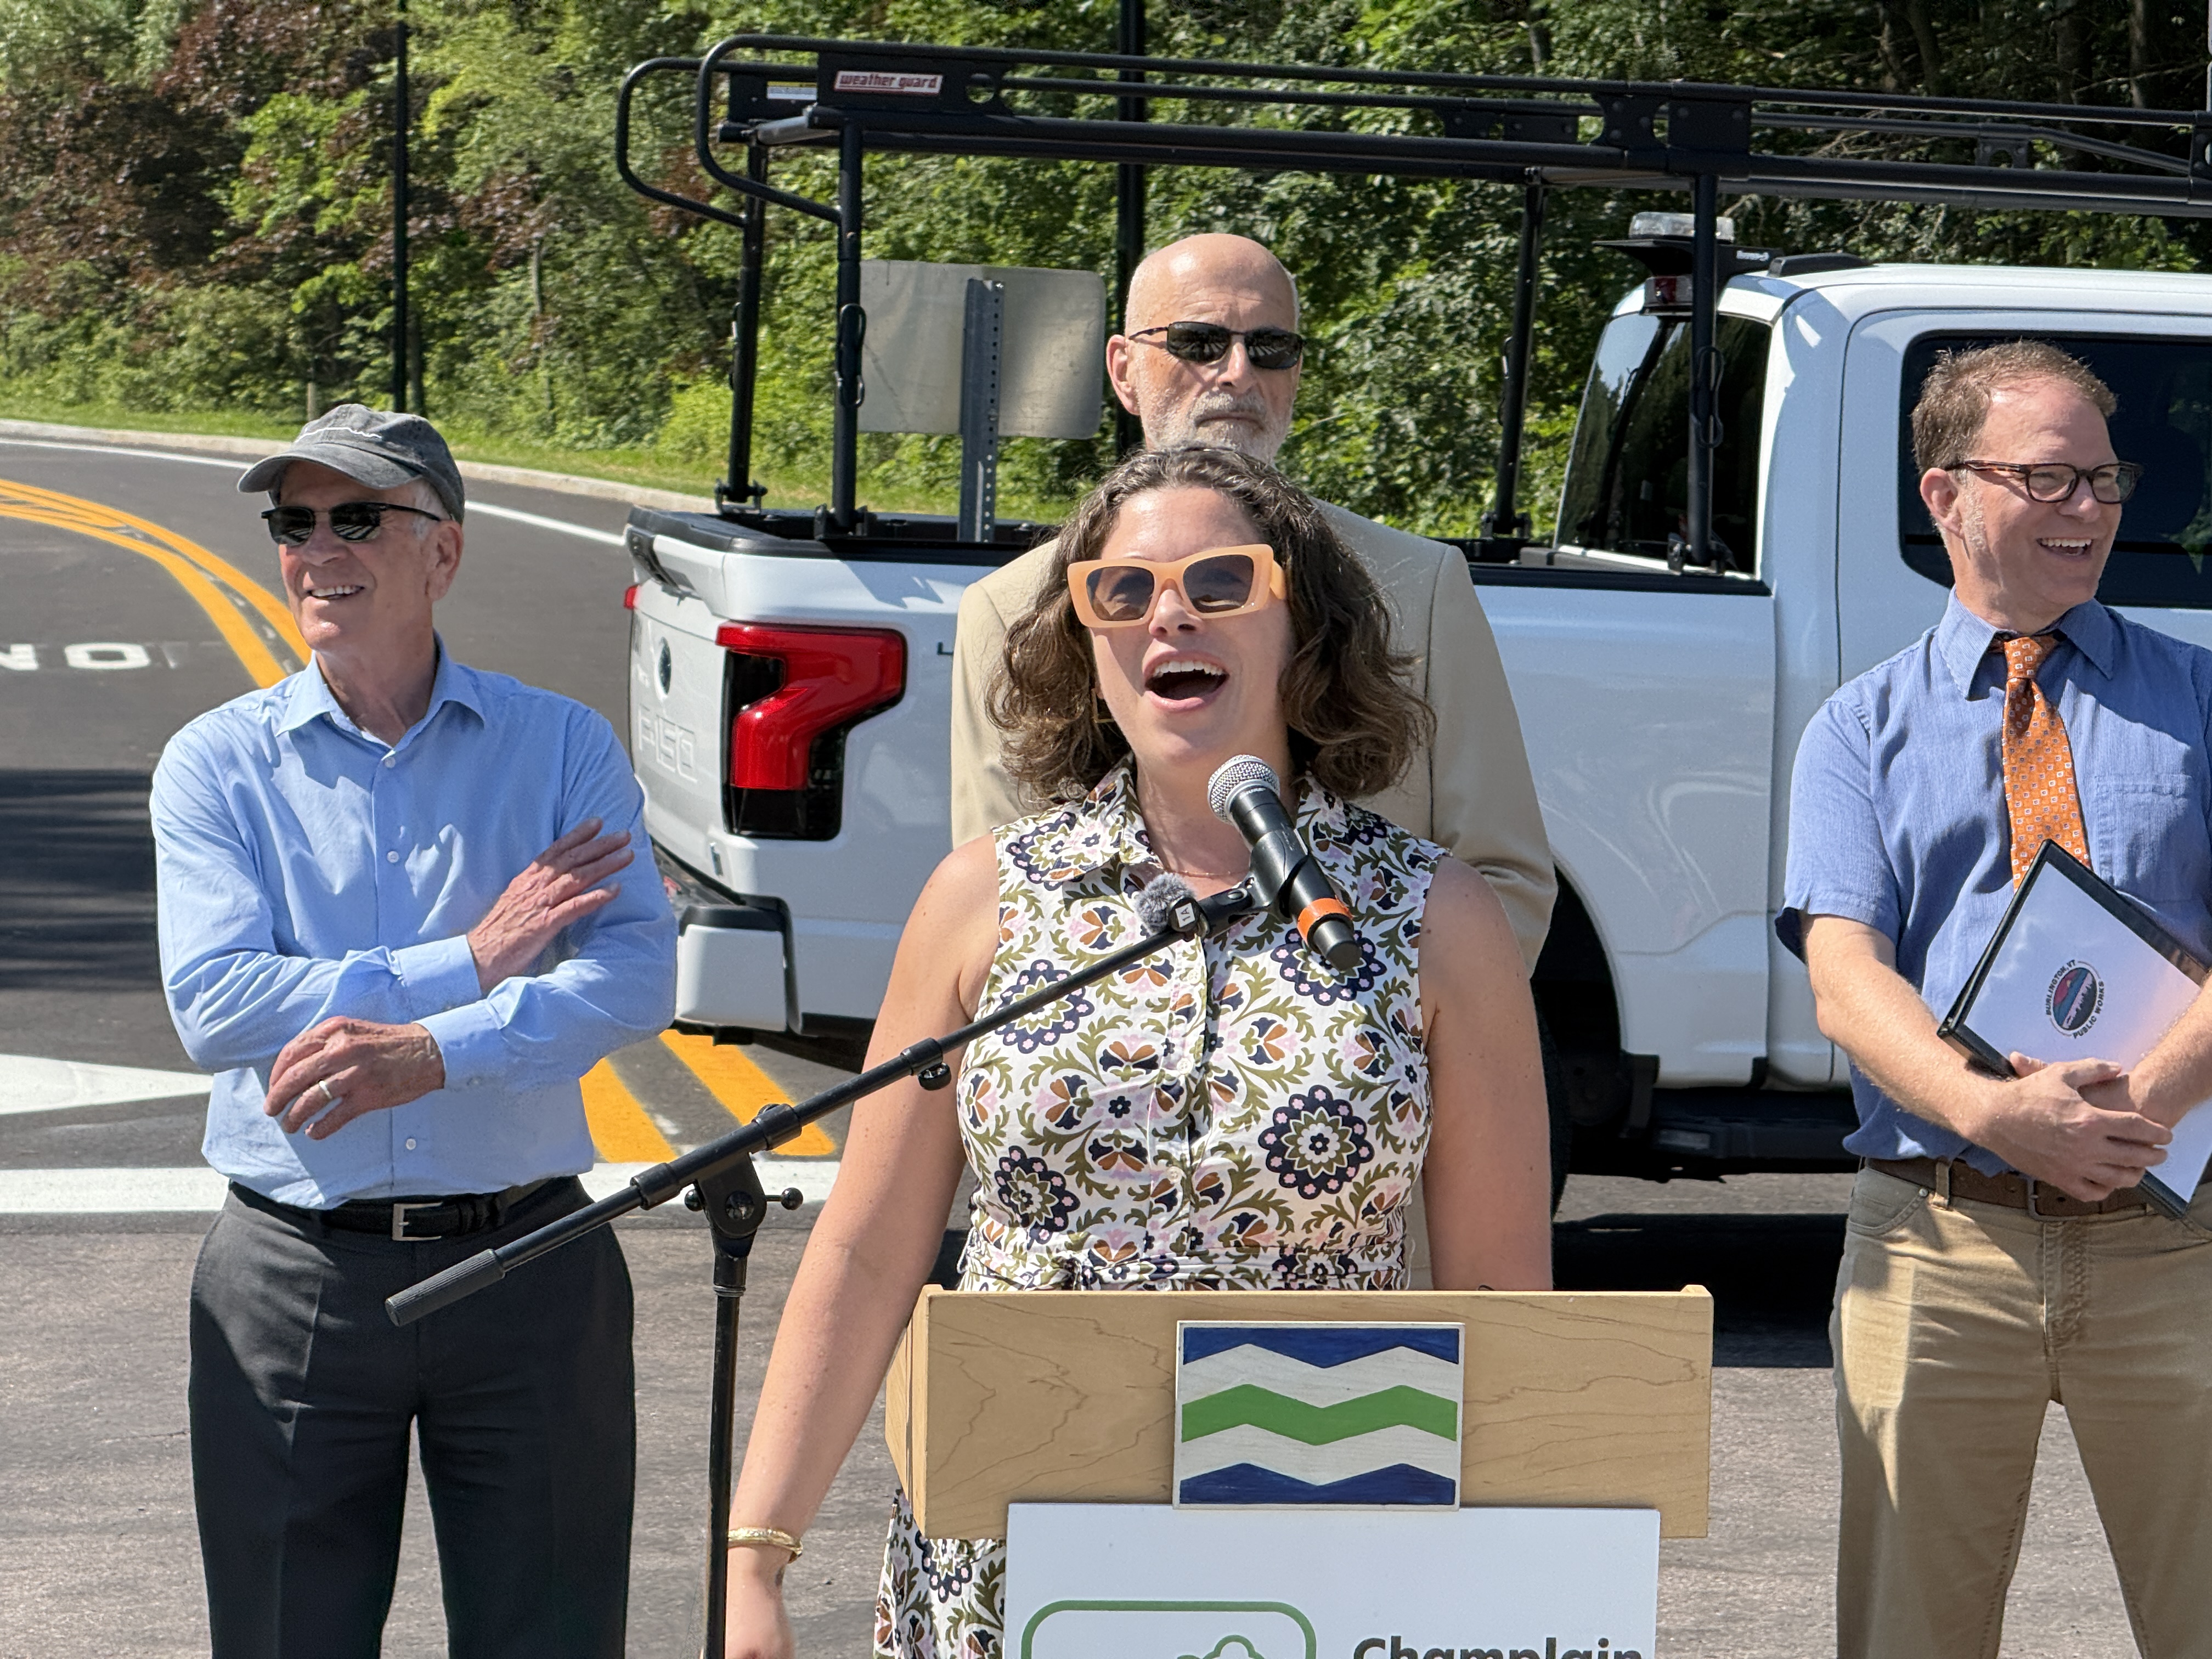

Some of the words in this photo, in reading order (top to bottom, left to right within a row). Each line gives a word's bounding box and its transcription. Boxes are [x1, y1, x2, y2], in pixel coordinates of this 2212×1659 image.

[840, 74, 896, 86] weather
[899, 76, 938, 88] guard
[2073, 1015, 2097, 1039] PUBLIC
[2095, 980, 2104, 1014] WORKS
